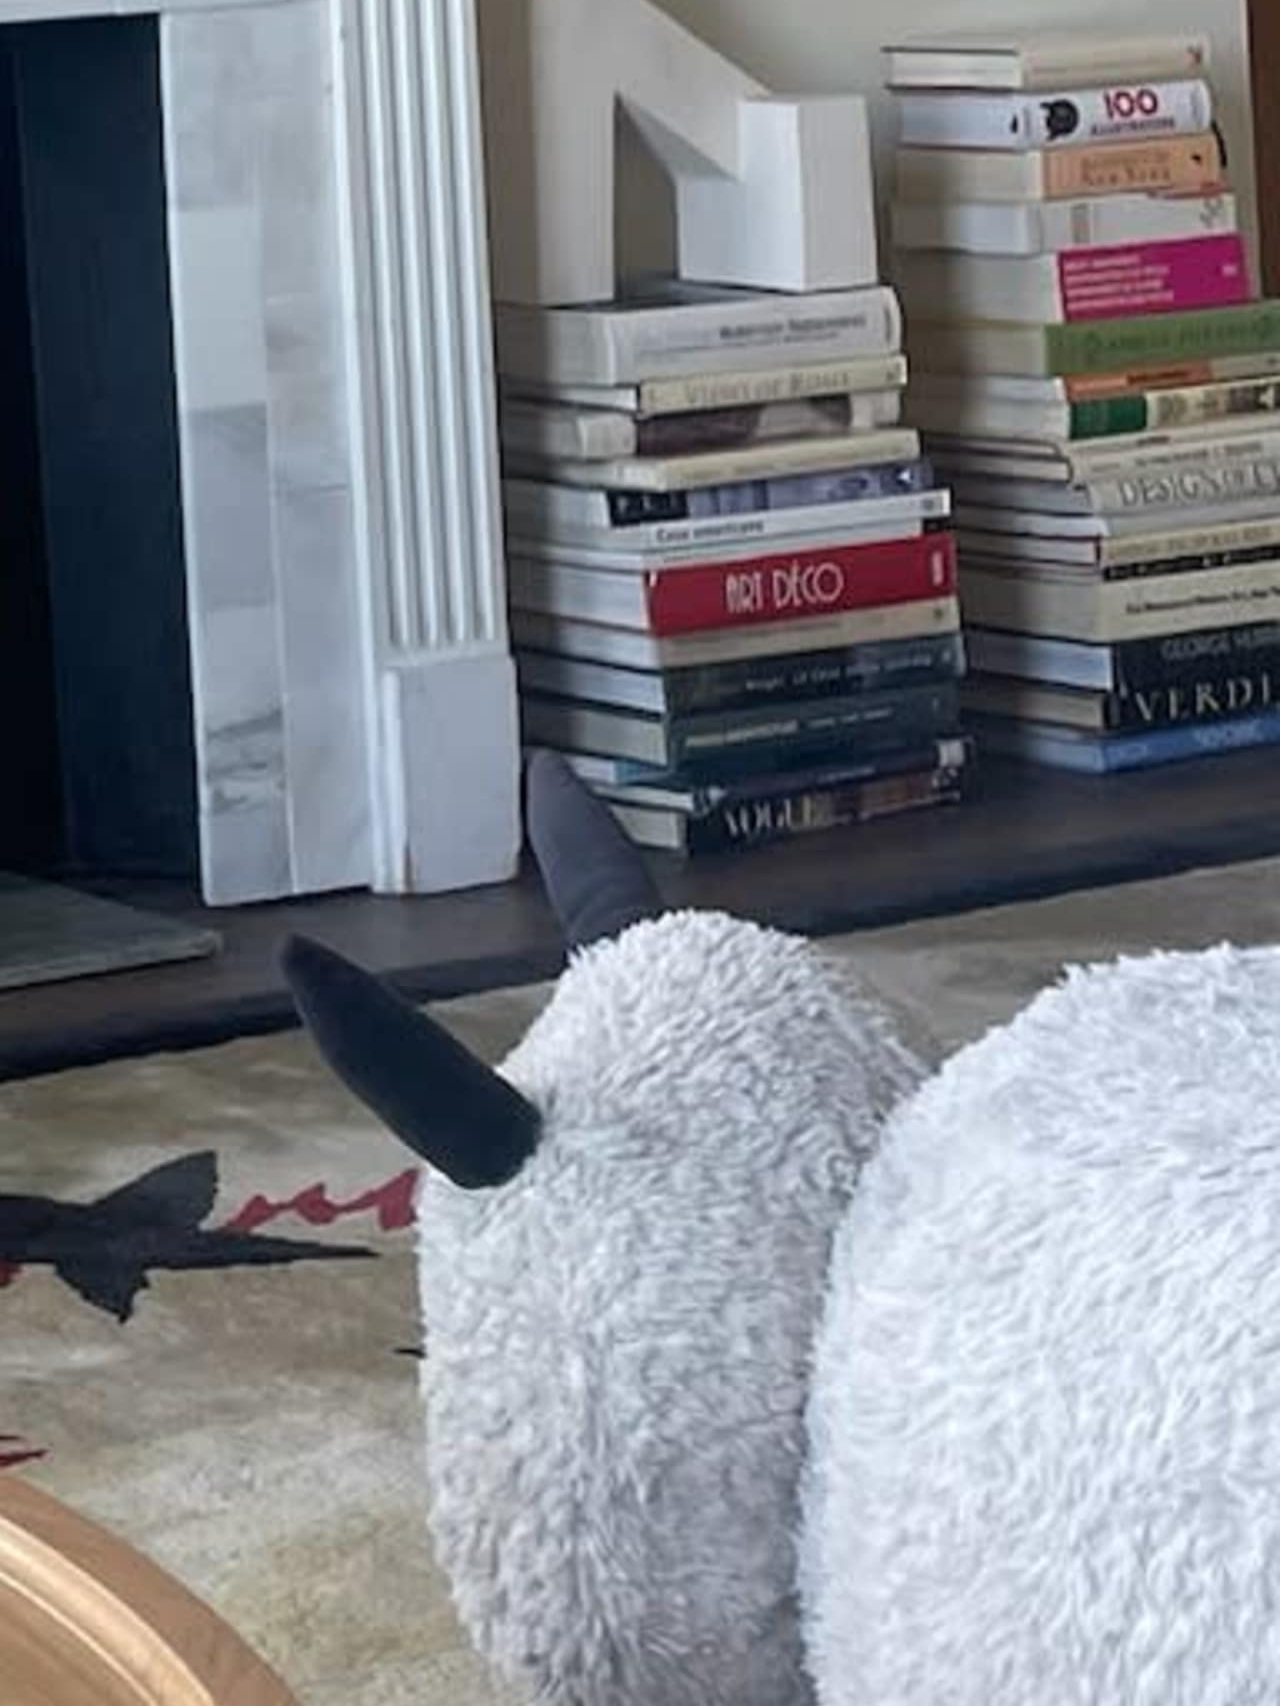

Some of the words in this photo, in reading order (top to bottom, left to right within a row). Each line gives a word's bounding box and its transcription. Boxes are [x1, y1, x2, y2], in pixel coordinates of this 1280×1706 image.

[1103, 89, 1159, 119] 100
[725, 571, 764, 614] ART
[1135, 673, 1270, 723] VERDI
